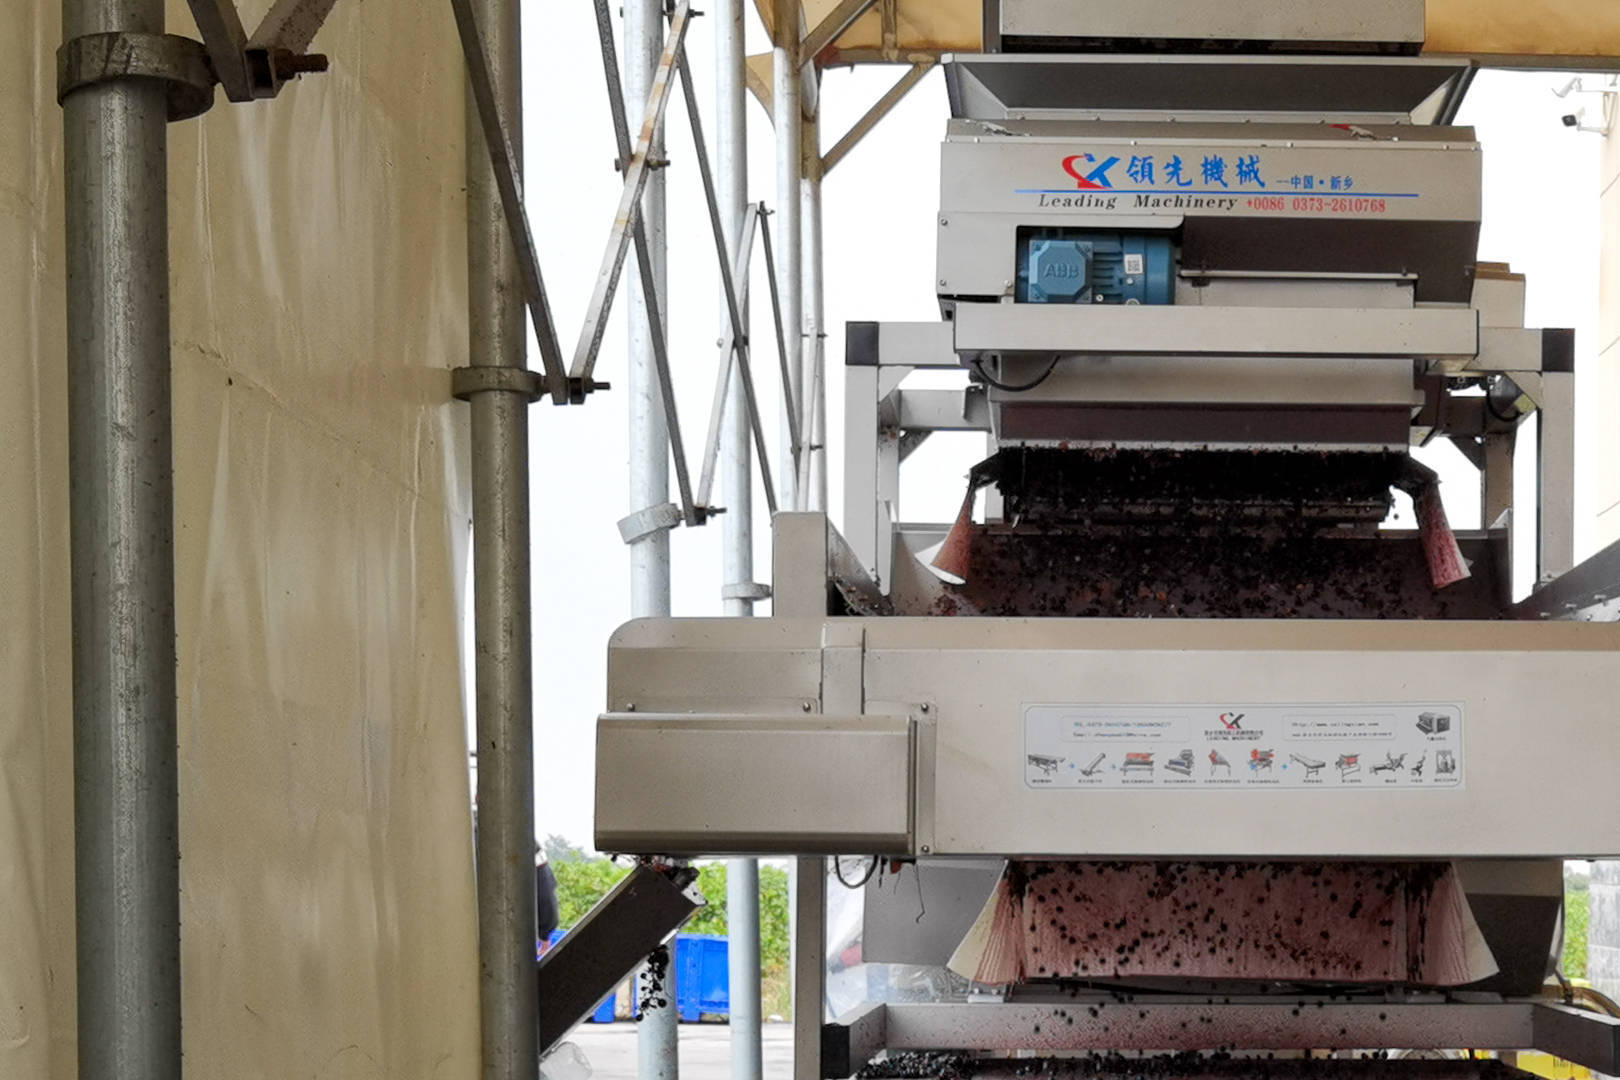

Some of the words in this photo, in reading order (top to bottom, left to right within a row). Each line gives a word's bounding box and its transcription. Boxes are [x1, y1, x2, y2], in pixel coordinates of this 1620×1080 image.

[1126, 154, 1266, 188] 領先機械
[1038, 194, 1118, 210] Leading
[1133, 194, 1238, 210] Machinery
[1246, 197, 1285, 212] +0086
[1292, 198, 1386, 213] 0373-2610768
[1044, 263, 1080, 279] ABB
